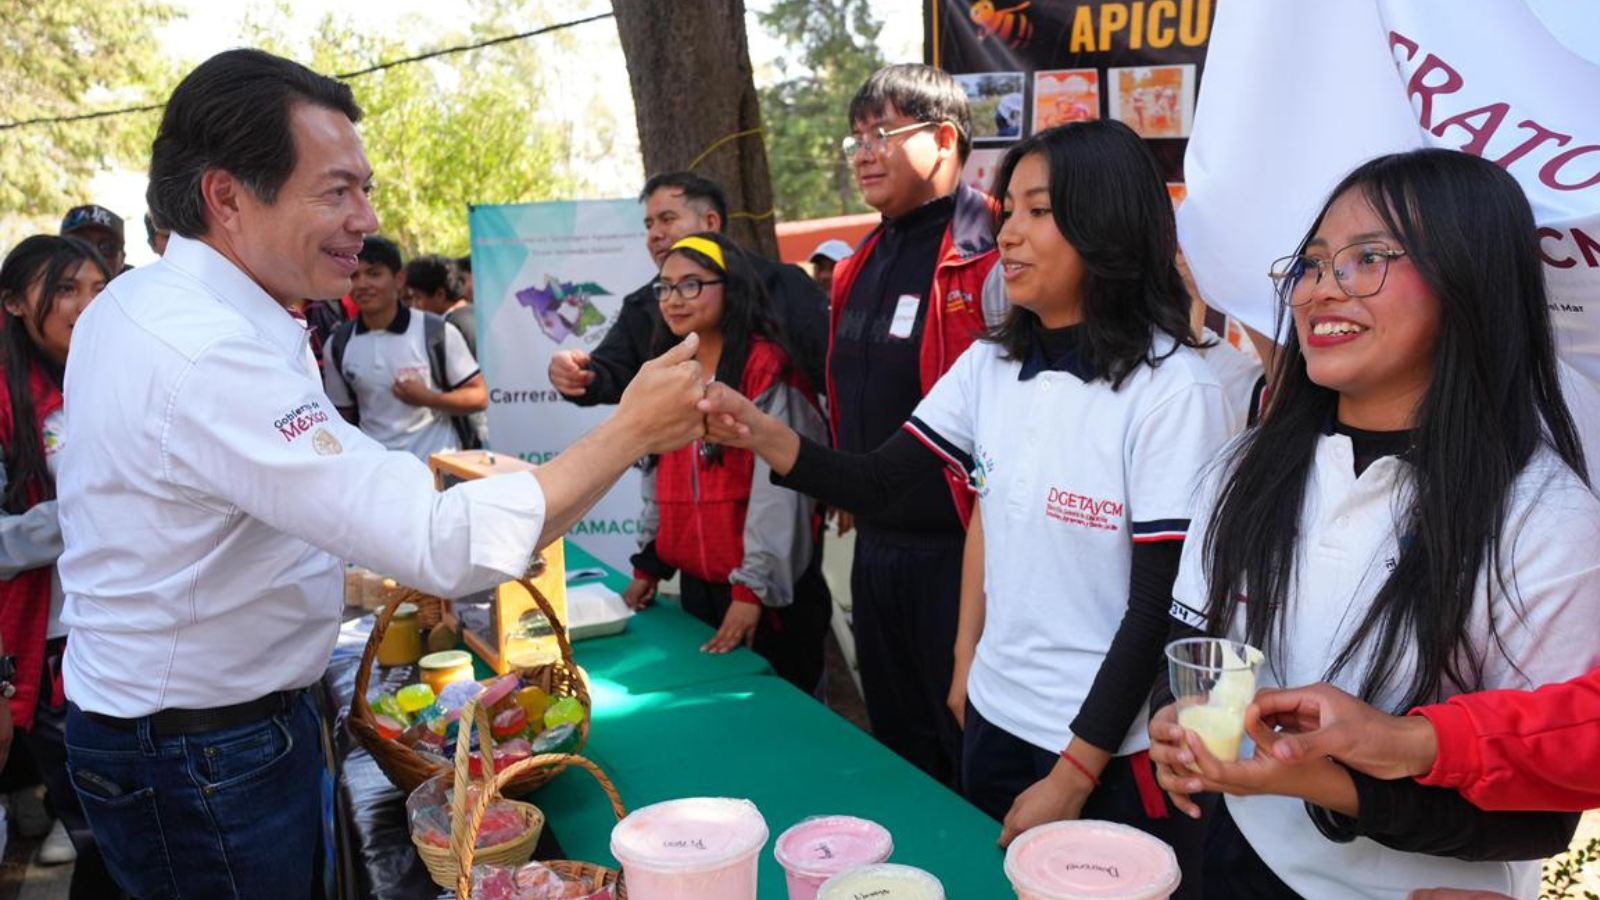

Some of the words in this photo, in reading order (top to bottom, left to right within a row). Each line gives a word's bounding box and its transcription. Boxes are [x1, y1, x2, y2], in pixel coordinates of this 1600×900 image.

[1070, 0, 1212, 53] APICU
[490, 388, 560, 404] Carrera
[279, 411, 328, 442] México
[570, 519, 642, 535] AMACI
